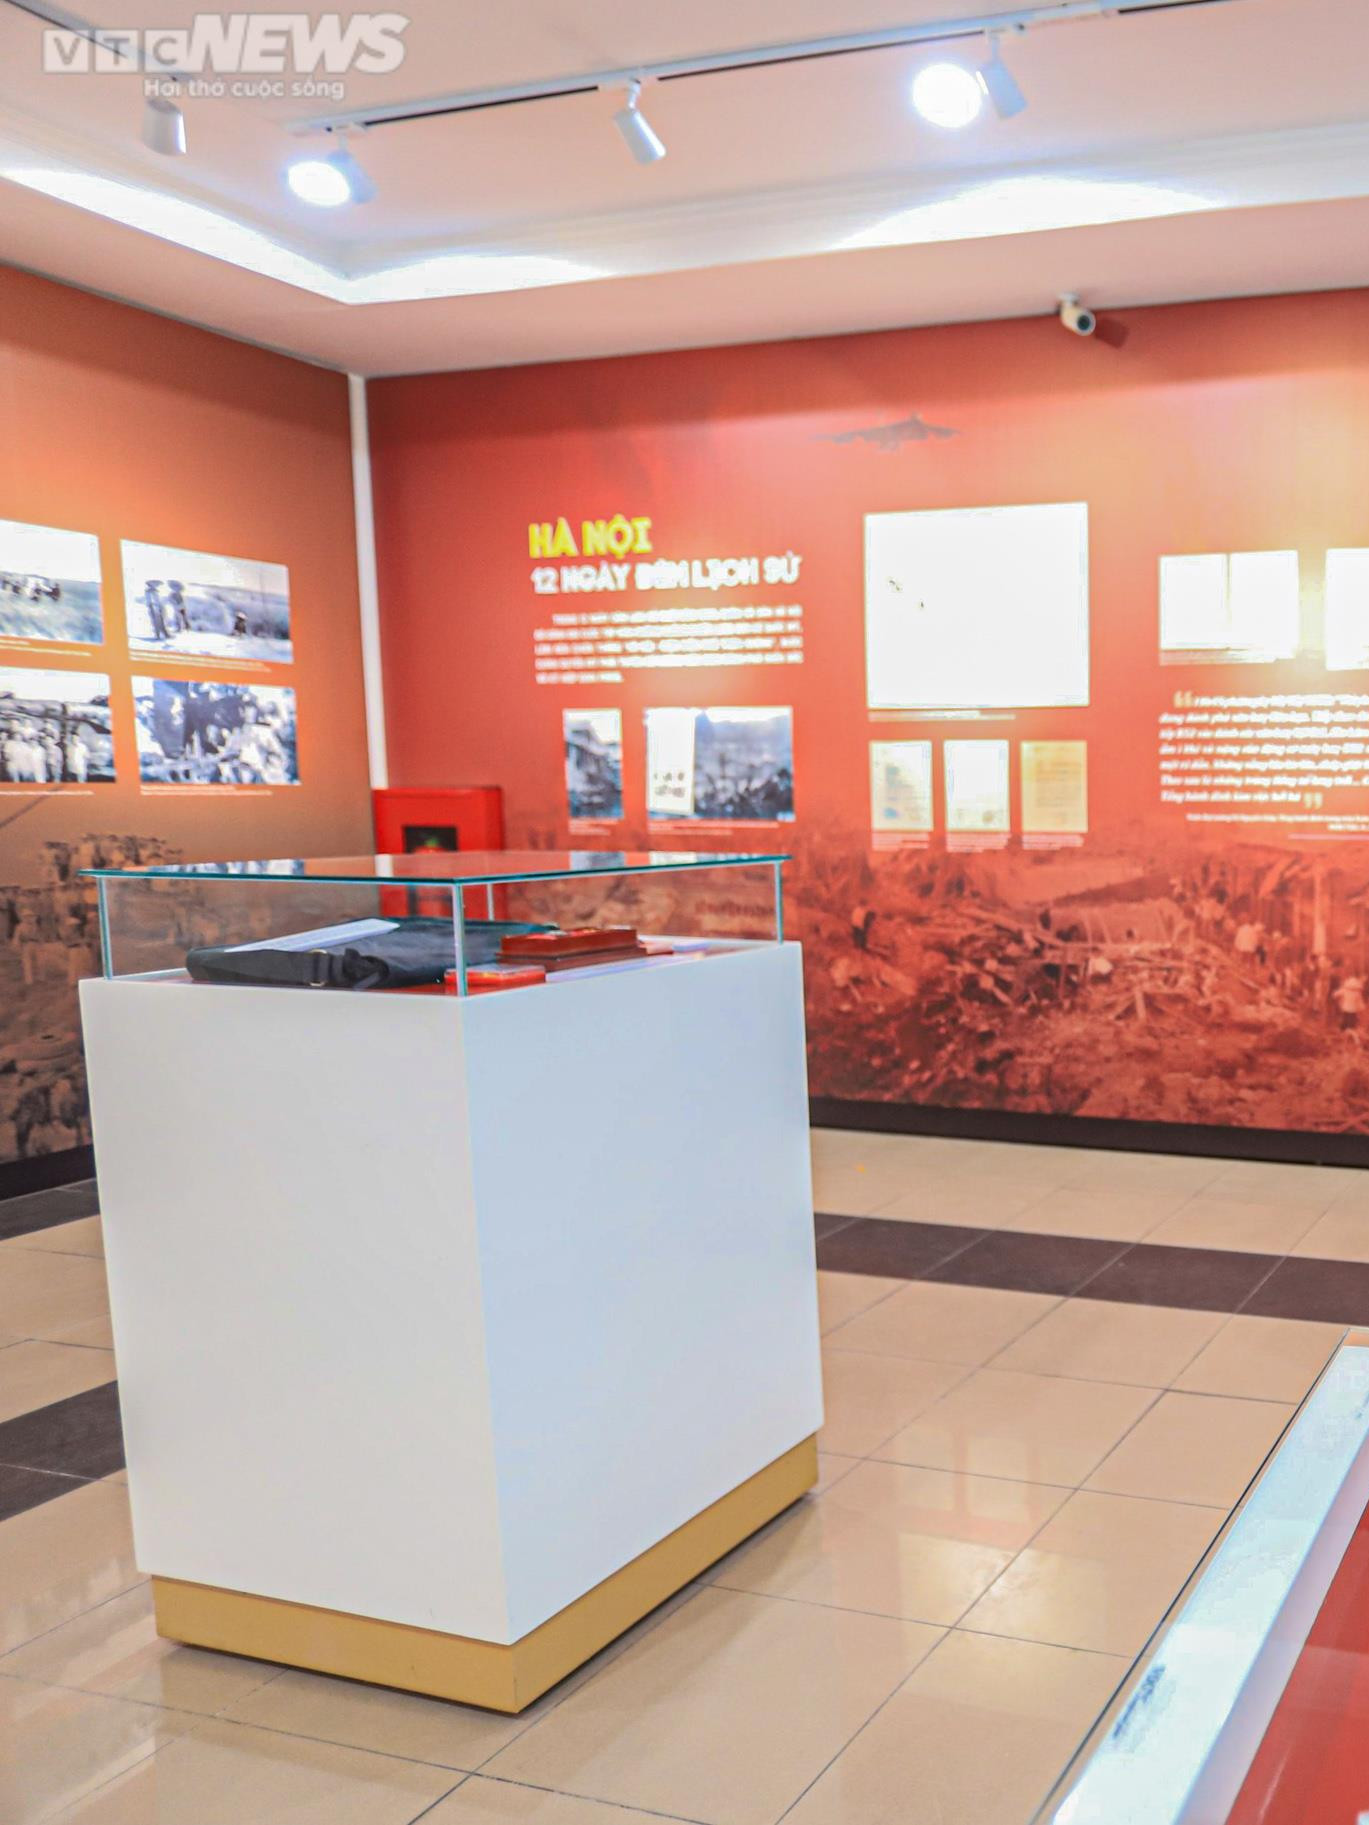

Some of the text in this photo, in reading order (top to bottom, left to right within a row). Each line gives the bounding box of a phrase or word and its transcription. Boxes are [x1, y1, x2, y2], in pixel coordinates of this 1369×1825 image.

[529, 514, 652, 559] HÀ NỘI
[531, 567, 558, 594] 12
[560, 561, 631, 592] NGÀY
